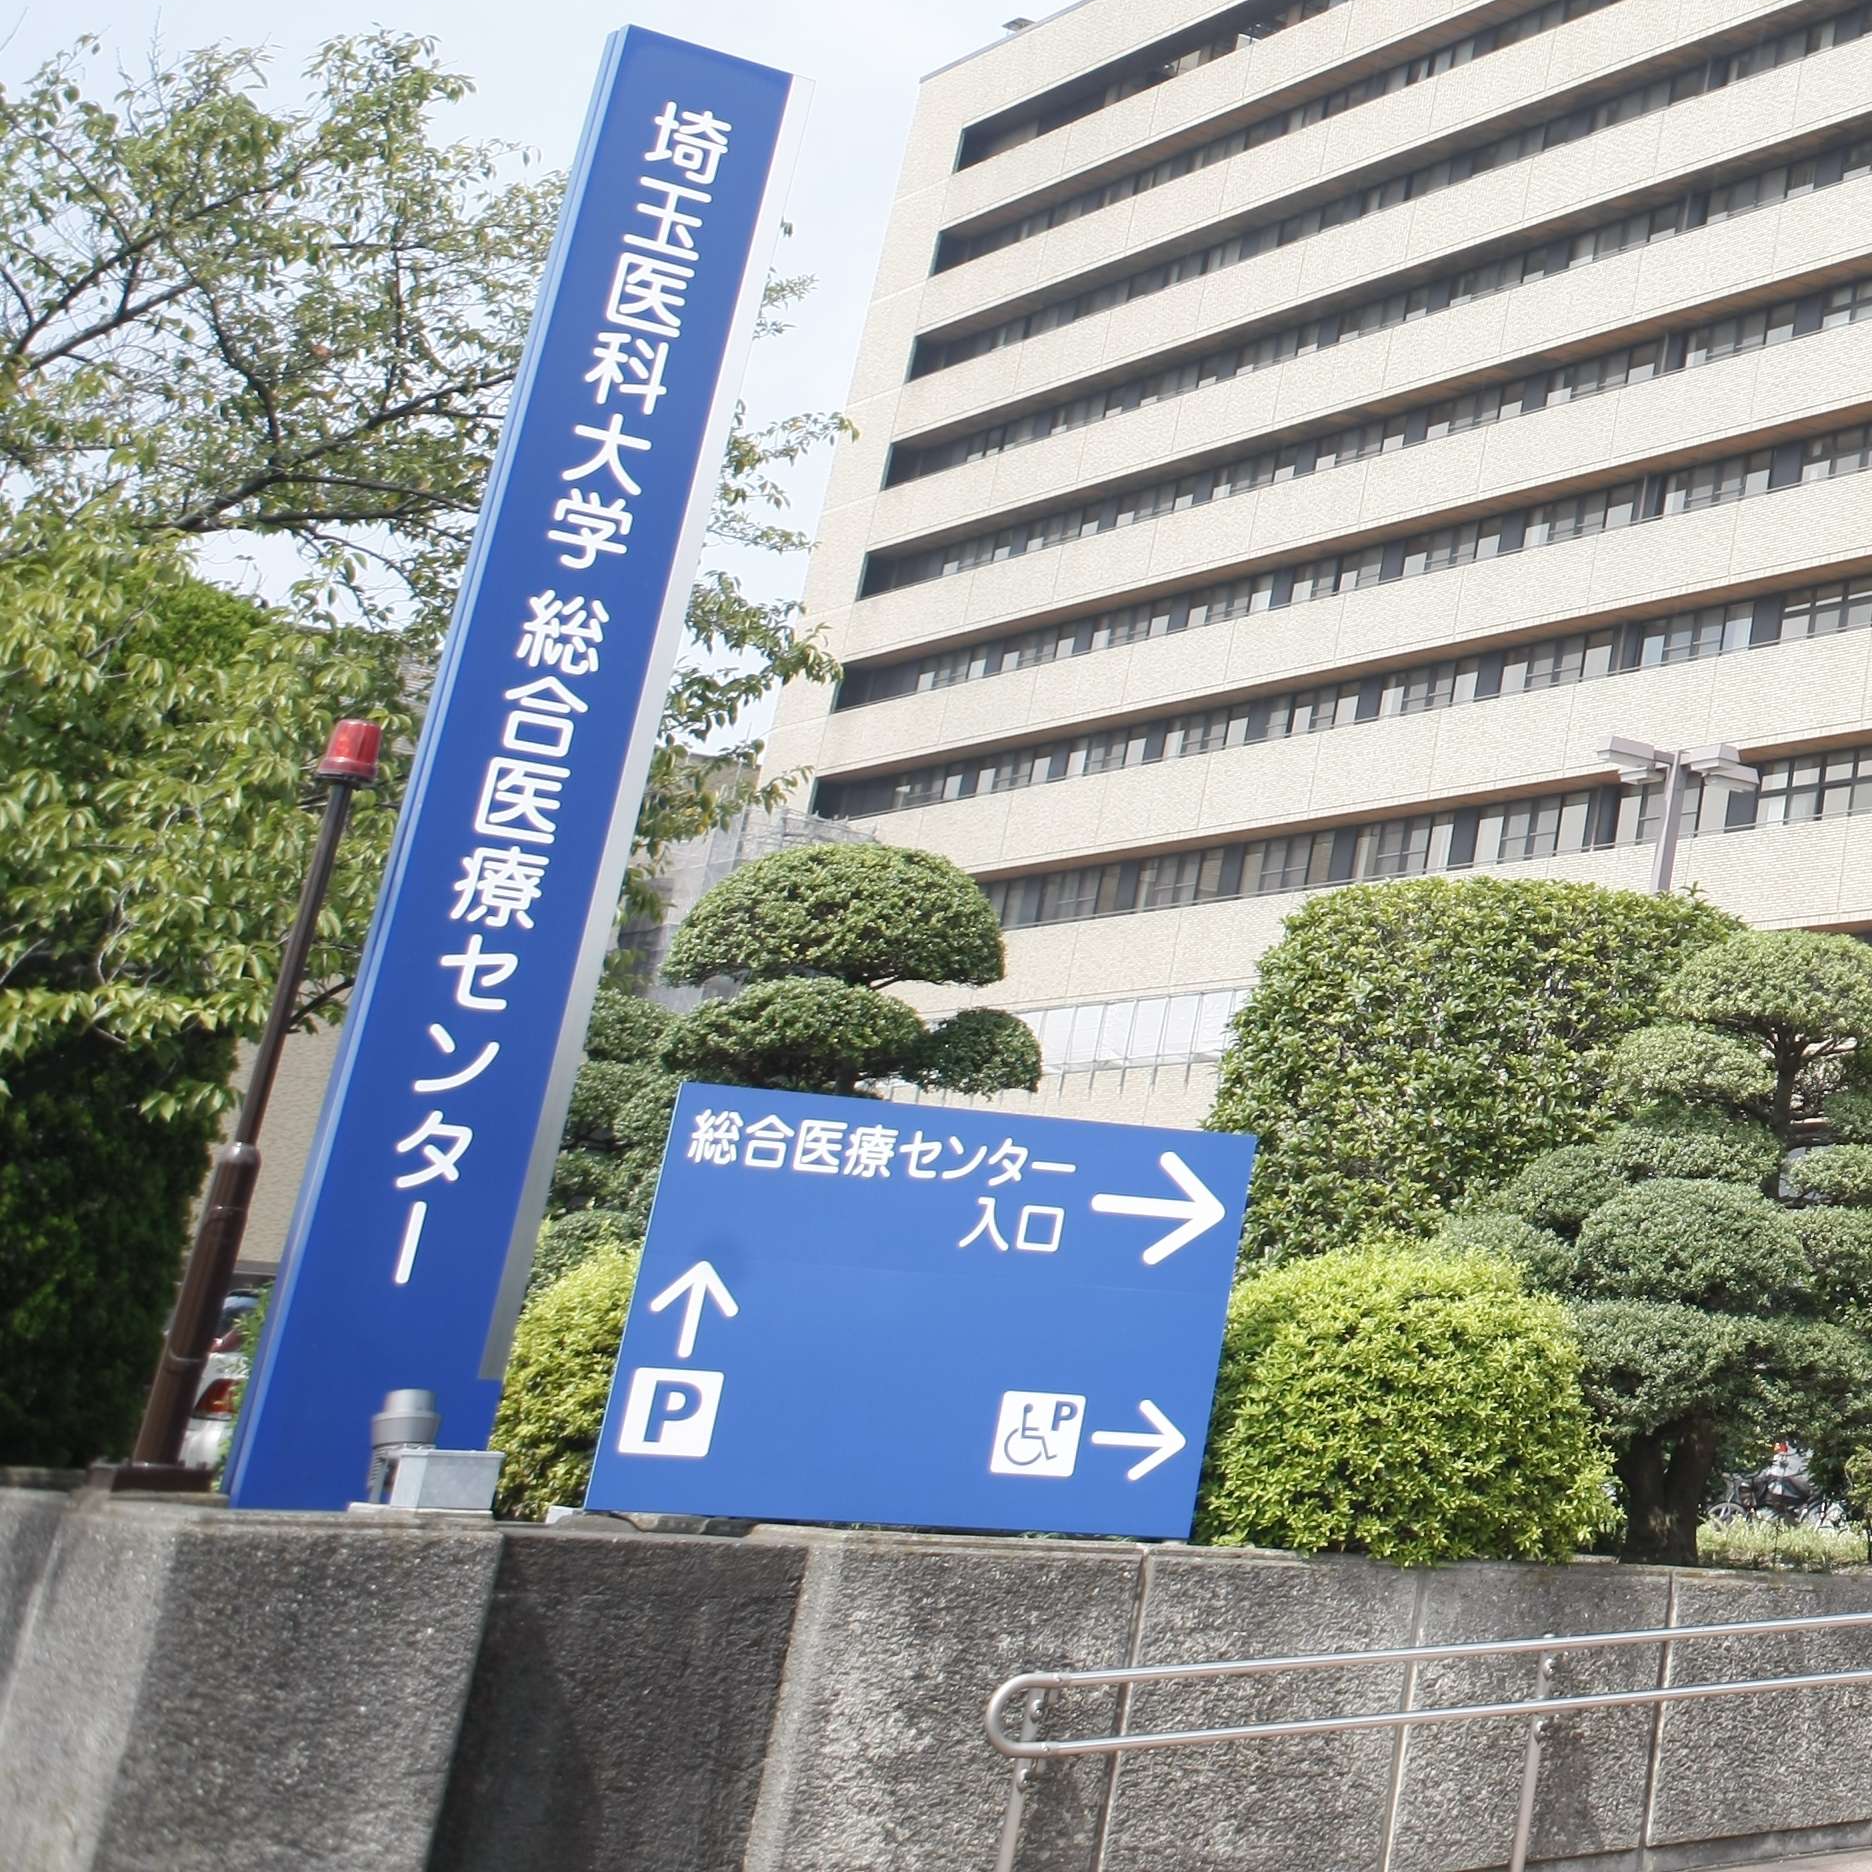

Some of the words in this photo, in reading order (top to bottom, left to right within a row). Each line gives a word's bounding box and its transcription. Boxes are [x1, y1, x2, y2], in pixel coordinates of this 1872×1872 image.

[547, 100, 732, 571] 埼玉医科大学
[391, 586, 611, 1286] 総合医療センター
[686, 1107, 1077, 1187] 総合医療センター
[958, 1196, 1065, 1253] 入口
[642, 1380, 702, 1443] P
[1050, 1400, 1078, 1432] P
